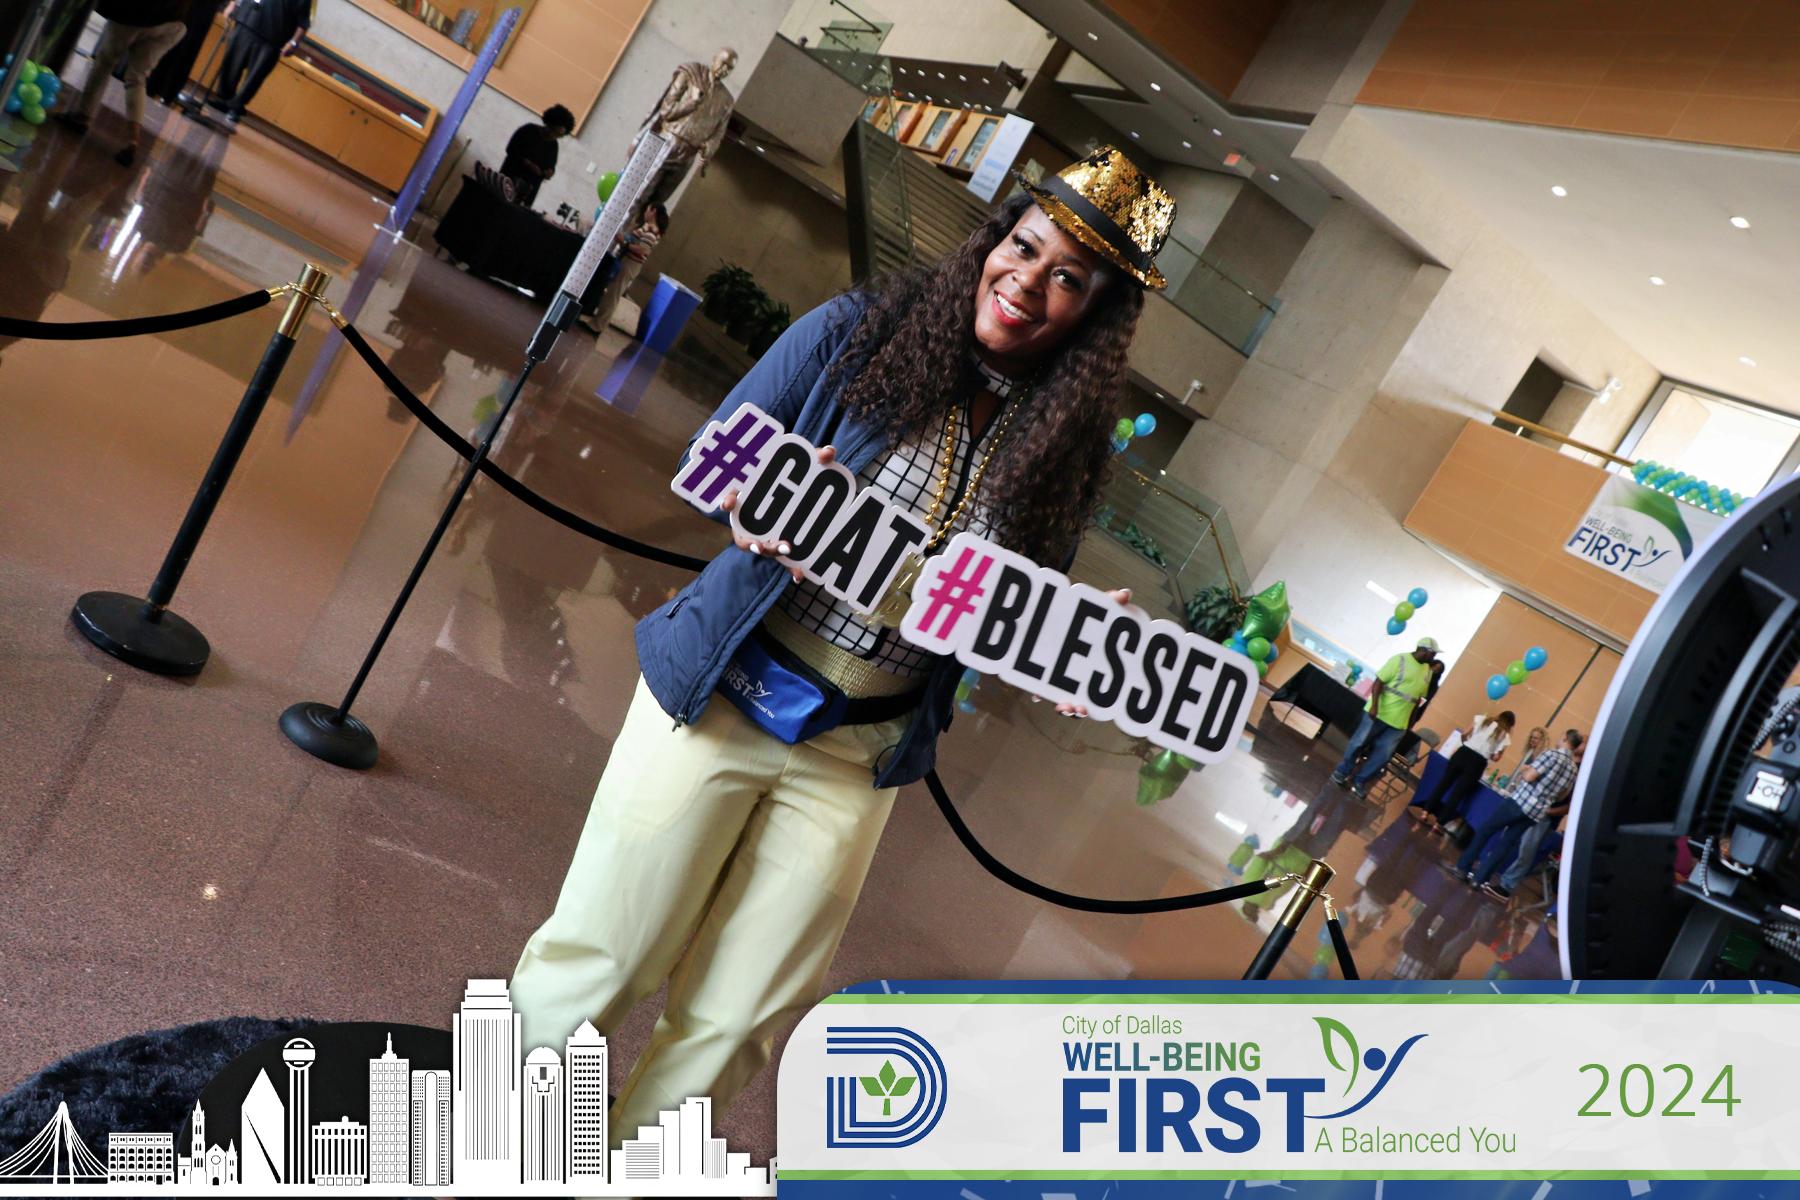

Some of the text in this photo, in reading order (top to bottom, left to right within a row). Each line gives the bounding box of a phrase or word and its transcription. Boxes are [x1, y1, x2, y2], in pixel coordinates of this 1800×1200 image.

[681, 412, 926, 610] #GOAT
[1584, 515, 1633, 544] WELL-BEING
[1567, 526, 1642, 572] FIRST
[916, 546, 1251, 753] #BLESSED
[725, 669, 754, 696] IRST
